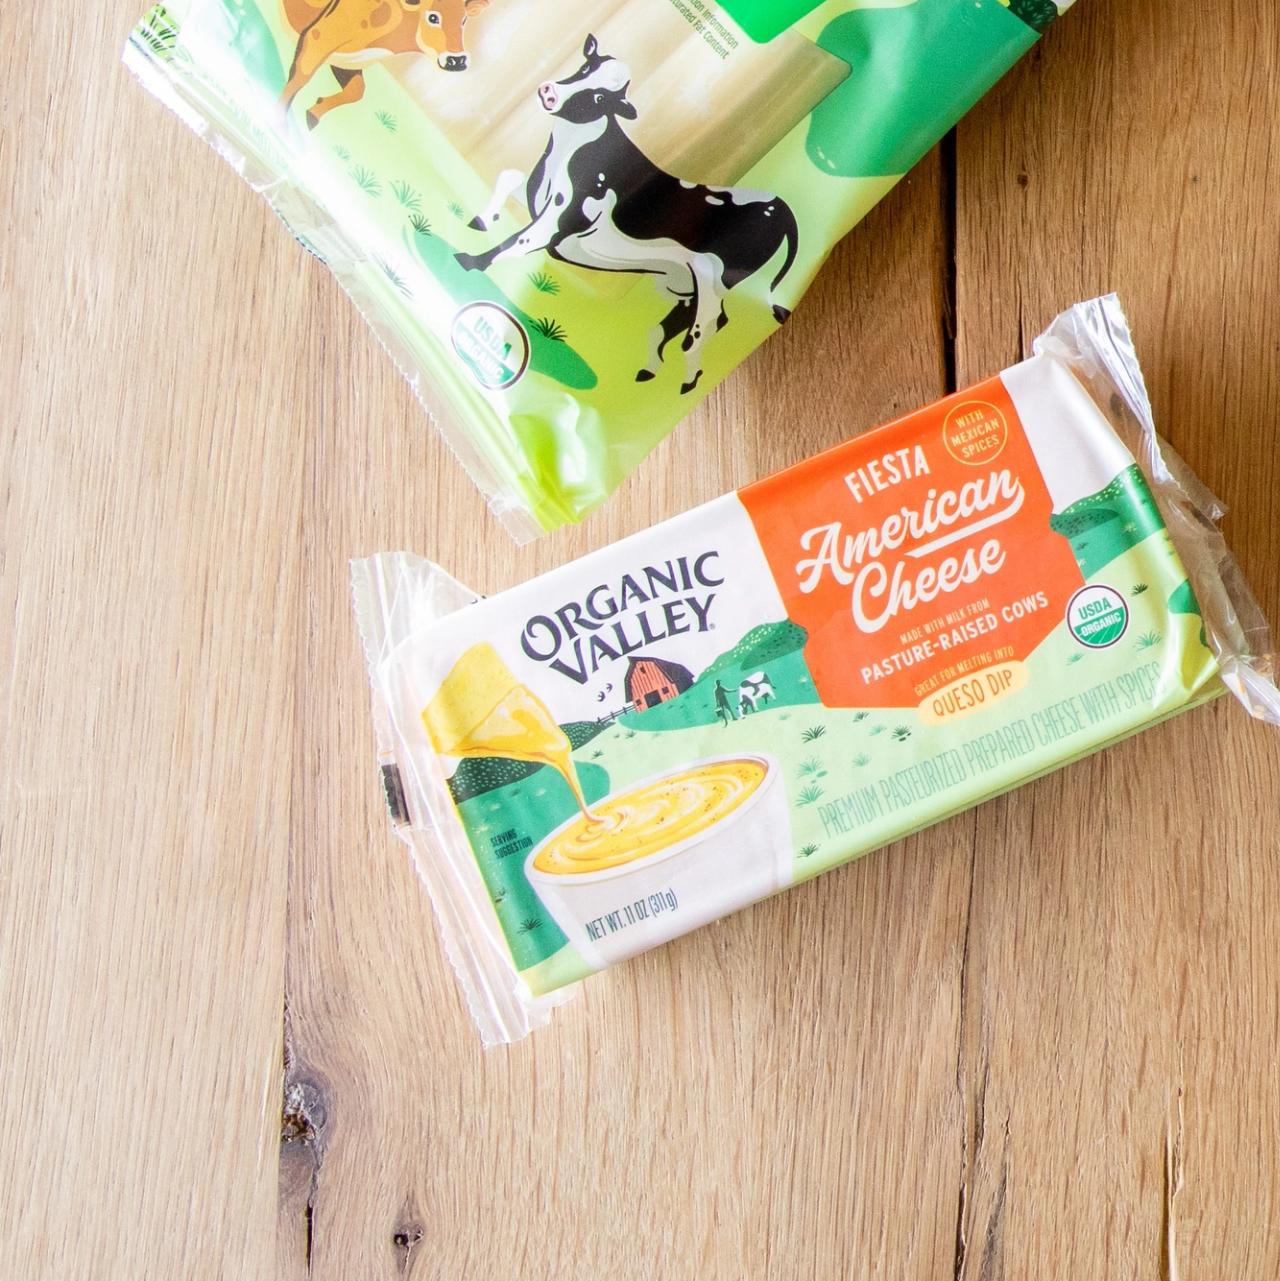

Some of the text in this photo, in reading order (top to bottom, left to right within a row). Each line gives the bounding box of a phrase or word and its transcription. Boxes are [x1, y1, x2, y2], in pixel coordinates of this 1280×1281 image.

[692, 18, 707, 35] Fat
[702, 28, 731, 60] Content
[701, 7, 741, 50] Information
[950, 418, 1000, 446] MEXICAN
[955, 409, 984, 428] WITH
[961, 433, 1000, 458] SPICES
[844, 445, 931, 502] FIESTA
[795, 468, 1023, 593] American
[521, 549, 724, 660] ORGANIC
[851, 538, 1005, 632] Cheese
[1078, 596, 1112, 620] USDA
[860, 590, 1049, 685] PASTURE-RAISED COWS
[899, 598, 990, 644] MADE WITH MILK FROM
[1080, 611, 1122, 637] ORGANIC
[913, 645, 1015, 697] GREAT FOR MELTING INTO
[930, 667, 1015, 718] QUESO DIP
[817, 784, 884, 839] PREMIUM
[878, 747, 969, 812] PASTEURIZED
[962, 718, 1036, 775] PREPARED
[1030, 696, 1086, 746] CHEESE
[1078, 681, 1123, 725] WITH
[490, 828, 518, 847] SERVING
[494, 835, 533, 859] SUGGESTION
[585, 887, 680, 941] NET WT. 11 OZ (311g)
